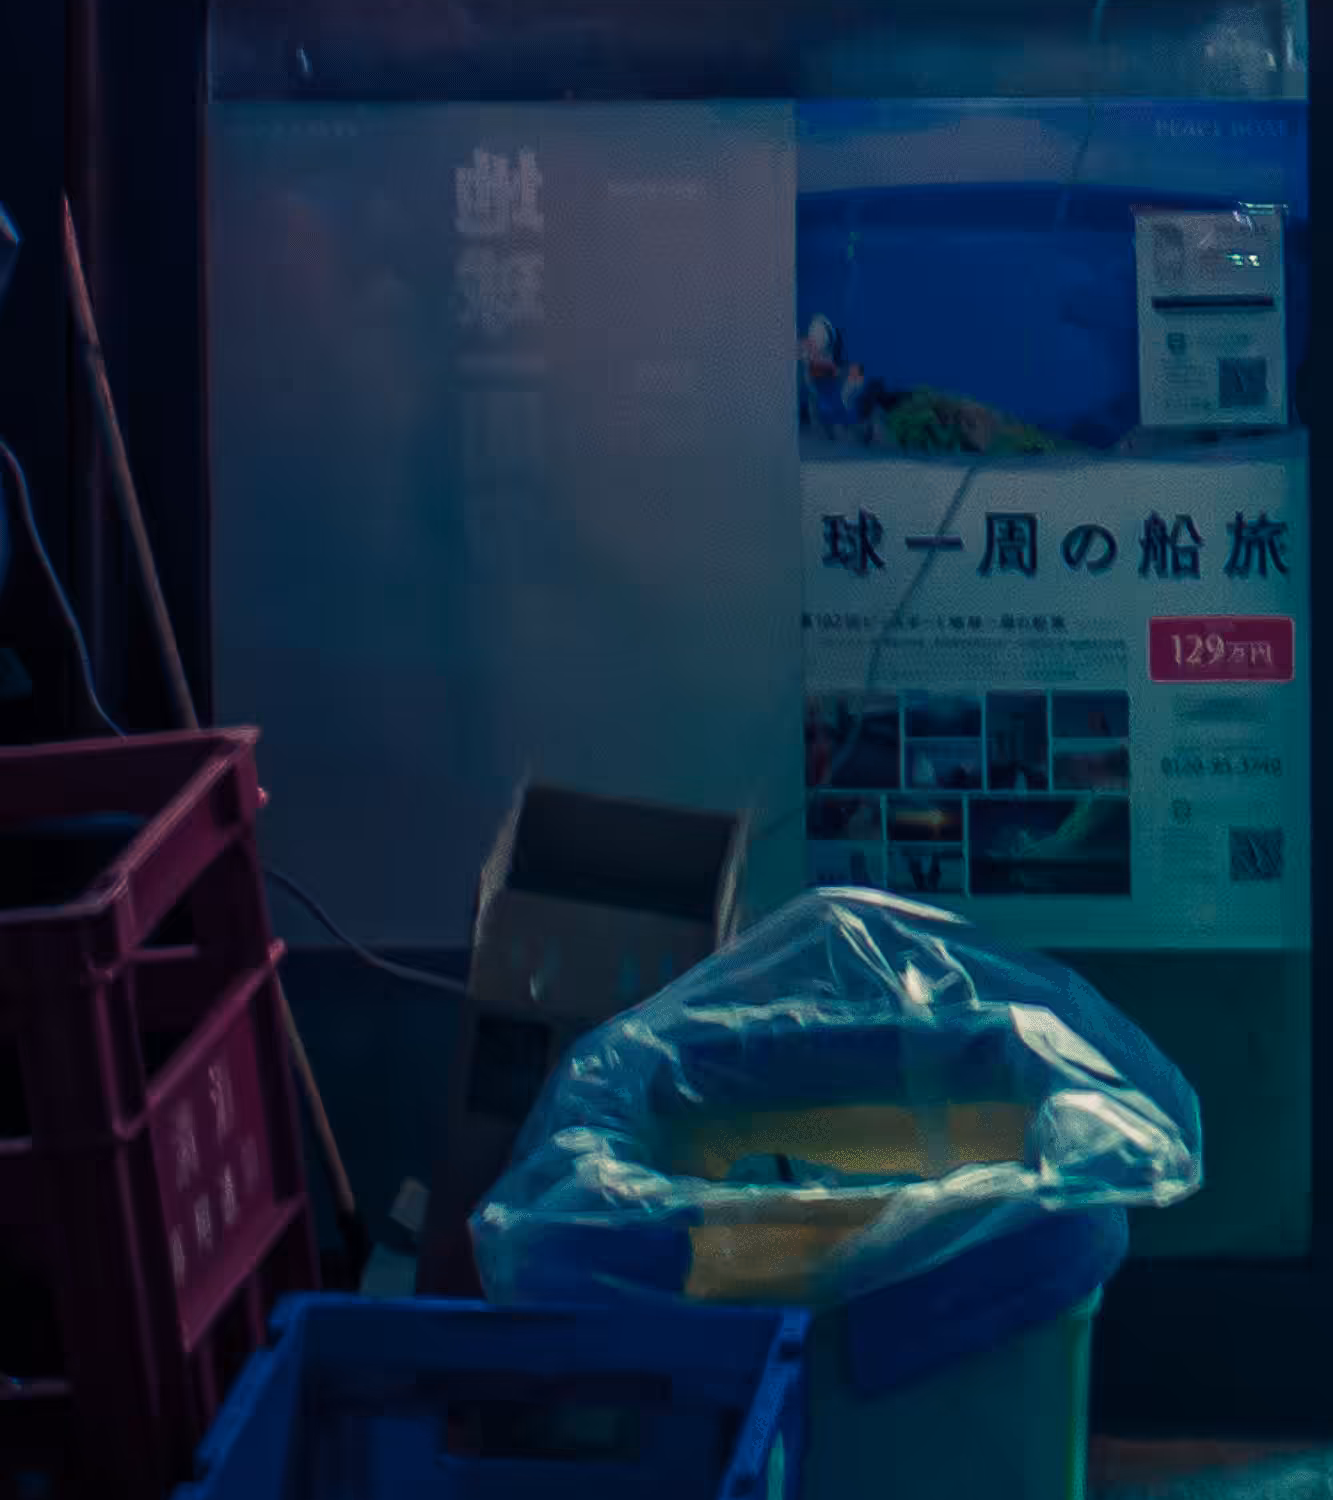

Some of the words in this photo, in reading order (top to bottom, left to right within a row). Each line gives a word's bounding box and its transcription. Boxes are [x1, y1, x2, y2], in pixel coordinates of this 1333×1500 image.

[820, 510, 1291, 580] 球一周の船旅
[1168, 631, 1275, 669] 129万円
